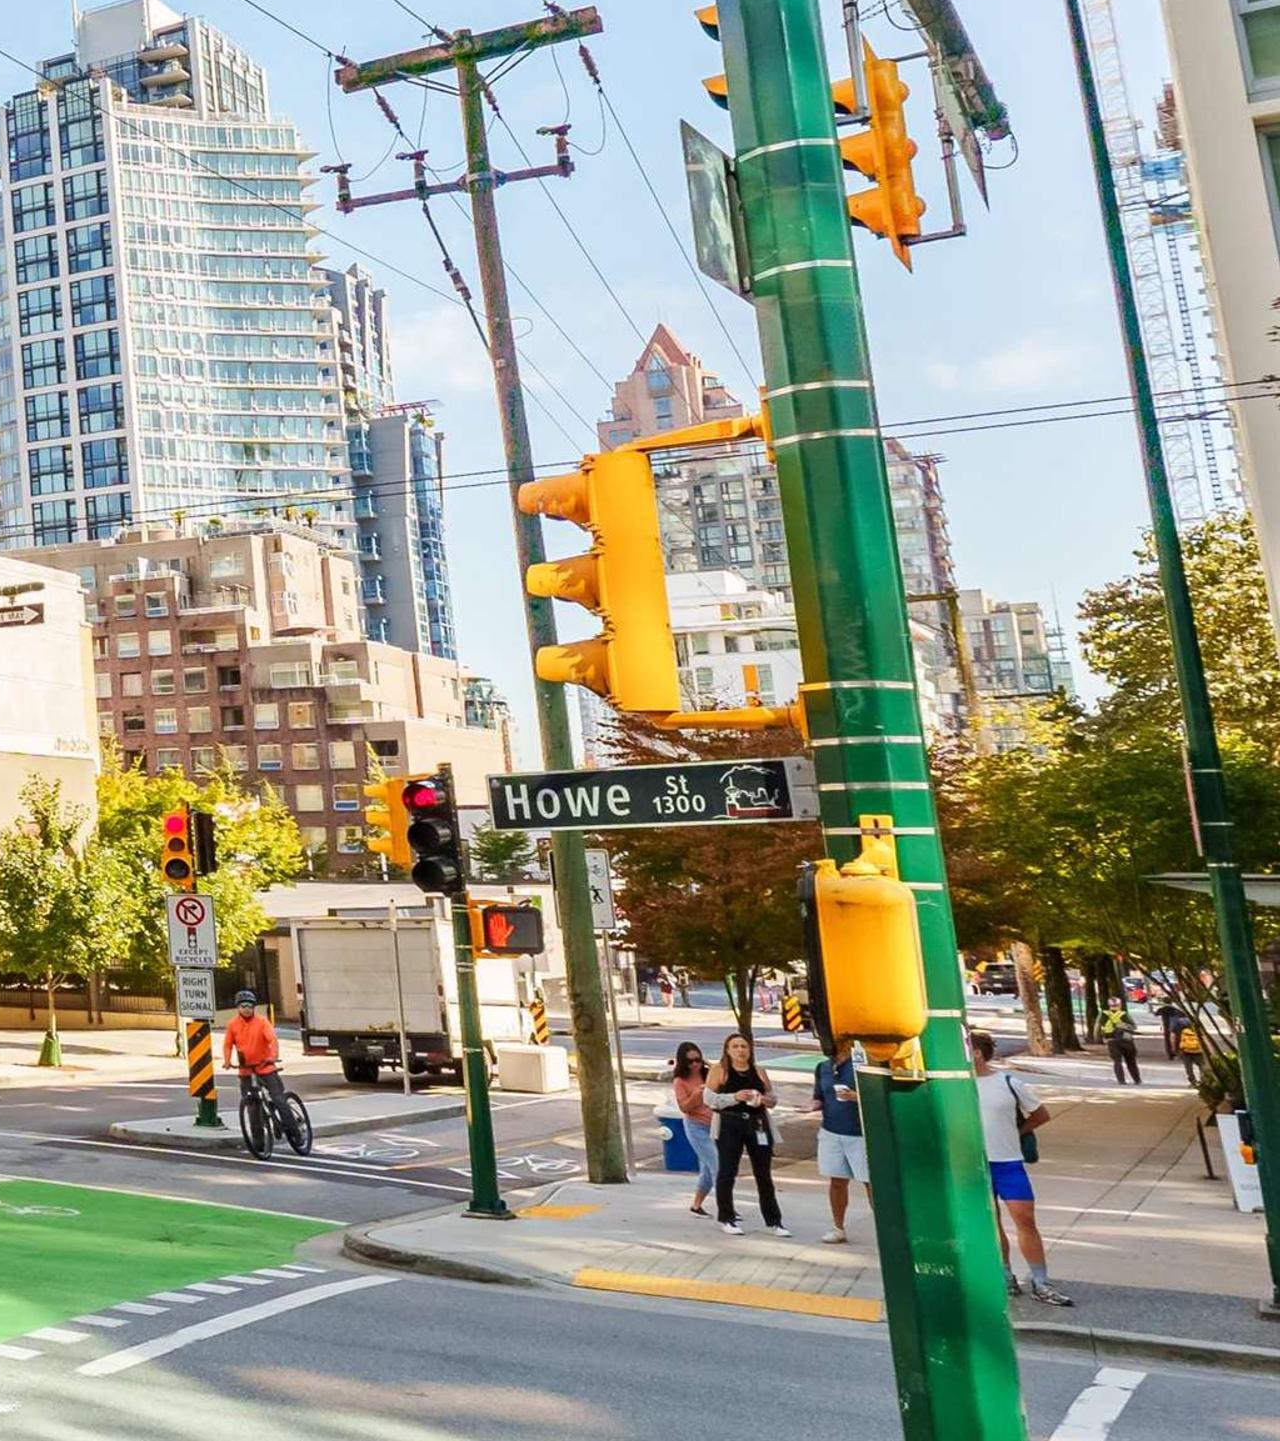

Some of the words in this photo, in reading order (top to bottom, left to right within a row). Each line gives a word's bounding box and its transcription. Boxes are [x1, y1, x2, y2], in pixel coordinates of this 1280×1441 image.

[504, 783, 631, 821] Howe
[666, 774, 690, 796] St
[652, 794, 707, 815] 1300
[175, 956, 213, 964] BICYCLES
[182, 977, 208, 986] RIGHT
[184, 989, 207, 998] TURN
[180, 1001, 213, 1011] SIGNAL
